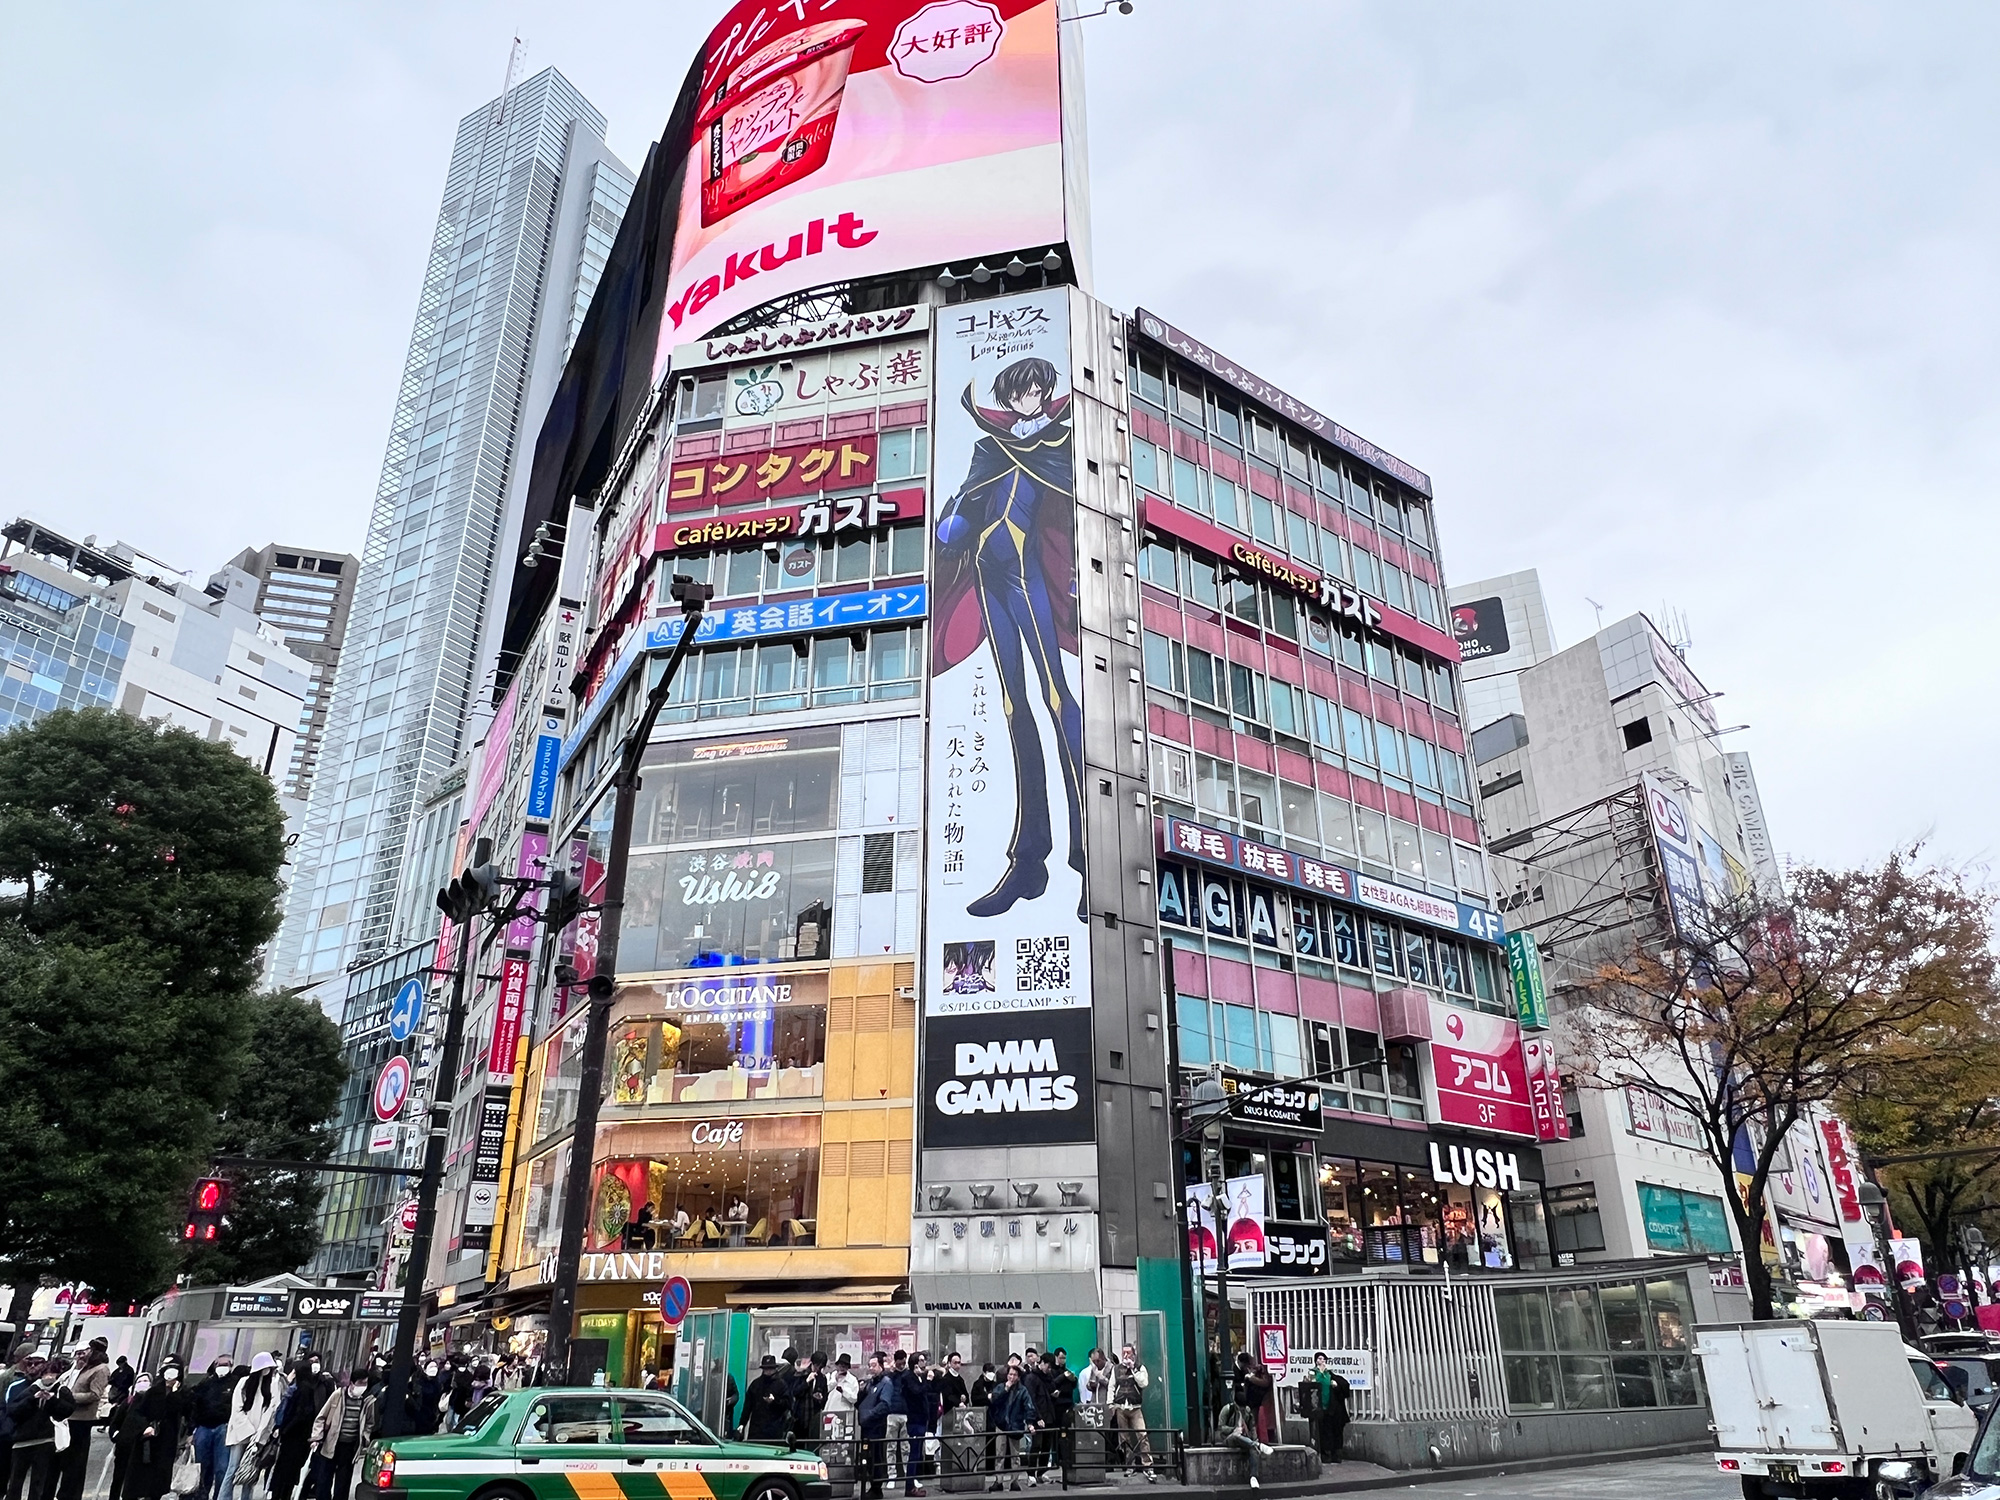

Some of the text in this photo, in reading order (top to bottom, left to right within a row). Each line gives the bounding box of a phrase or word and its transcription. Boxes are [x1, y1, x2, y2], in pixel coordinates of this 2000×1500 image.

[900, 22, 993, 54] 大好評
[726, 108, 800, 157] ヤクルト
[667, 212, 879, 330] Yakult
[706, 309, 915, 360] しゃぶしゃぶバイキング
[956, 305, 1051, 335] コードギアス
[984, 325, 1048, 343] 反逆のルルーシュ
[796, 349, 922, 399] しゃぶ葉
[1164, 324, 1327, 431] しゃぶしゃぶバイキング
[671, 444, 871, 499] コンタクト
[798, 496, 898, 536] ガスト
[788, 559, 812, 570] ガスト
[1321, 579, 1382, 628] ガスト
[653, 616, 717, 640] AEN
[1458, 639, 1479, 651] OHO
[551, 632, 572, 695] 献血ルーム
[1460, 645, 1492, 658] NEMAS
[970, 666, 989, 793] これは、きみの
[943, 725, 966, 886] 「失われた物語」
[1738, 794, 1770, 866] CAMERA
[1178, 823, 1347, 895] 薄毛 抜毛 発毛
[680, 870, 781, 906] Ushi8
[1159, 871, 1275, 940] AGA
[511, 935, 529, 946] 4F
[1468, 909, 1499, 940] 4F
[366, 997, 397, 1015] SHIBU
[503, 961, 524, 1021] 外貨両替
[664, 983, 793, 1010] L'OCCITANE
[685, 1010, 767, 1023] EN PROVENCE
[955, 1038, 1058, 1077] DMM
[1450, 1053, 1513, 1095] アコム
[493, 1074, 509, 1083] 7F
[935, 1075, 1079, 1116] GAMES
[1244, 1105, 1263, 1116] DRUG
[1477, 1103, 1496, 1125] 3F
[1532, 1079, 1550, 1119] アコム
[691, 1121, 743, 1150] Café
[1429, 1141, 1521, 1192] LUSH
[925, 1301, 1041, 1311] SHIBUYA EKIMAE A
